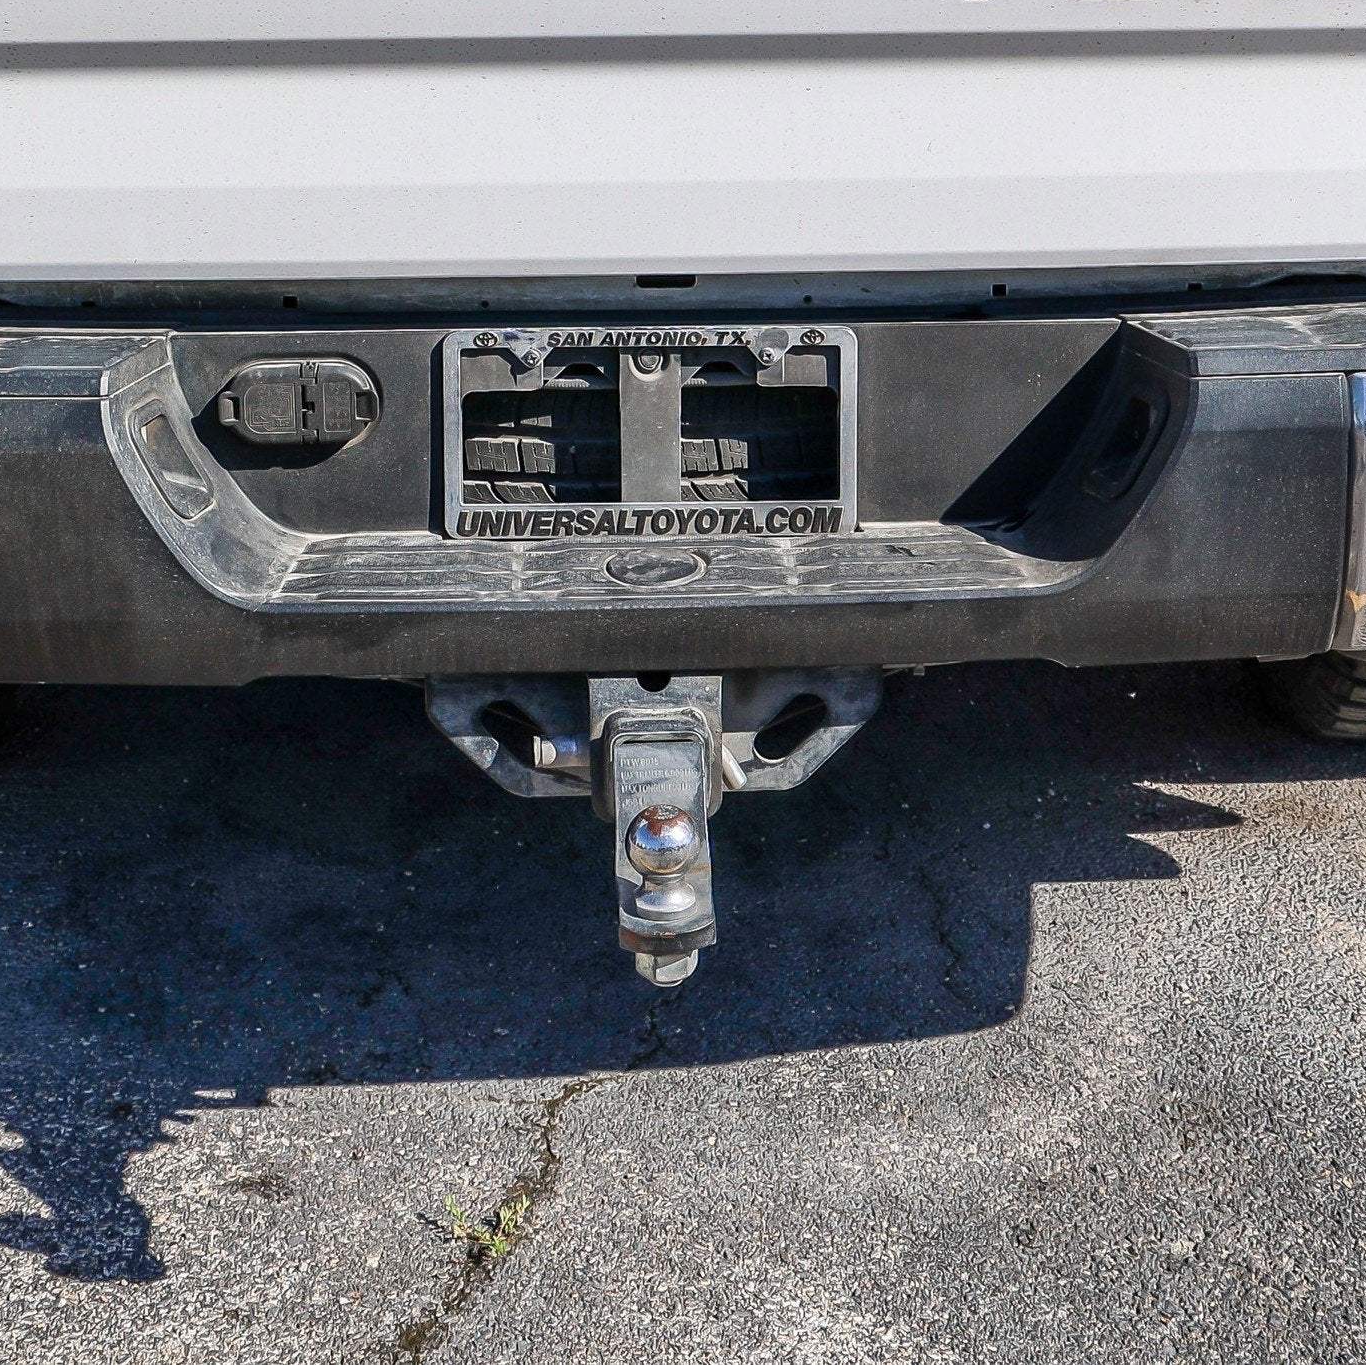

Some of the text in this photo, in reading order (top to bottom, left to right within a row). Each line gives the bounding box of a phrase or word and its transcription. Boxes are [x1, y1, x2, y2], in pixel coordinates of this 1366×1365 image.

[547, 330, 753, 347] SAN ANTONIO, TX.
[456, 506, 845, 537] UNIVERSALTOYOTA.COM
